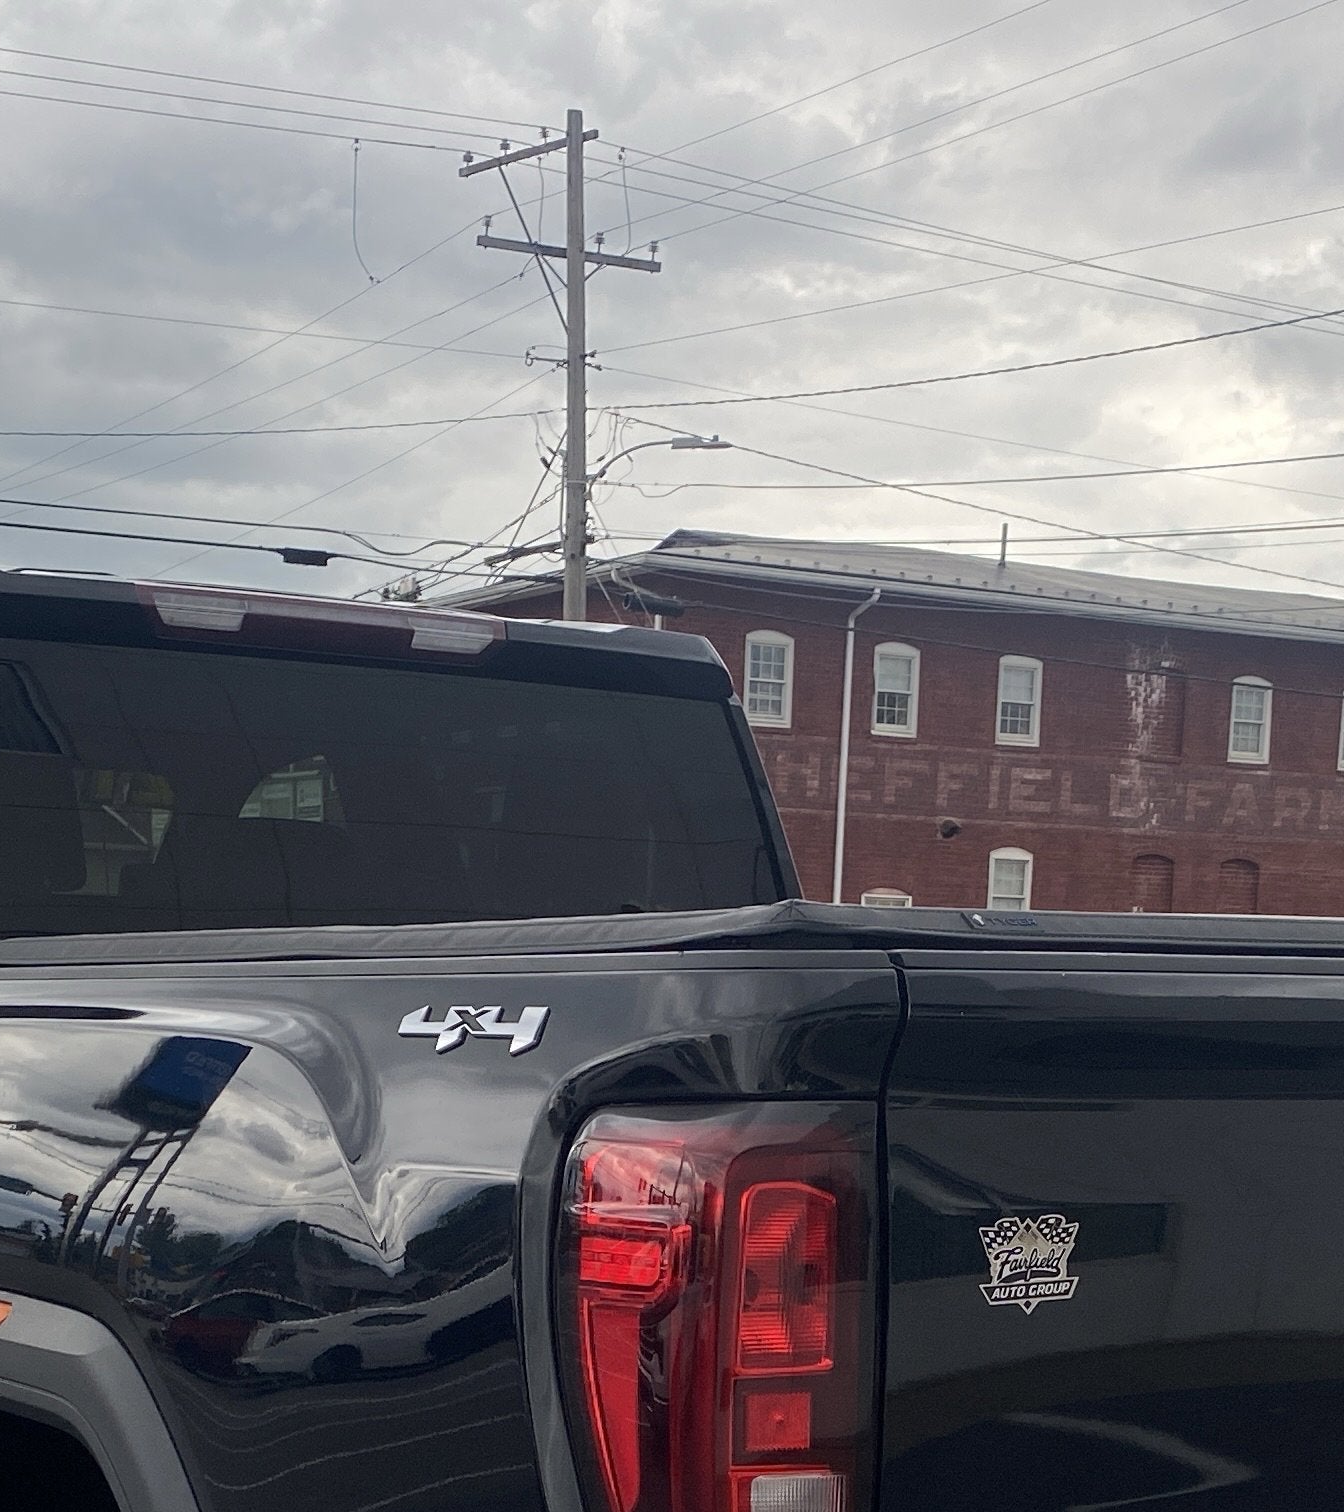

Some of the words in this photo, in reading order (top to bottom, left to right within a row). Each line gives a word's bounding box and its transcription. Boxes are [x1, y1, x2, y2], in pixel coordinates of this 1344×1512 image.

[756, 745, 1149, 820] HEFFIELD
[993, 1246, 1066, 1283] Fairfield
[991, 1286, 1026, 1300] AUTO
[1028, 1282, 1070, 1296] GROUP
